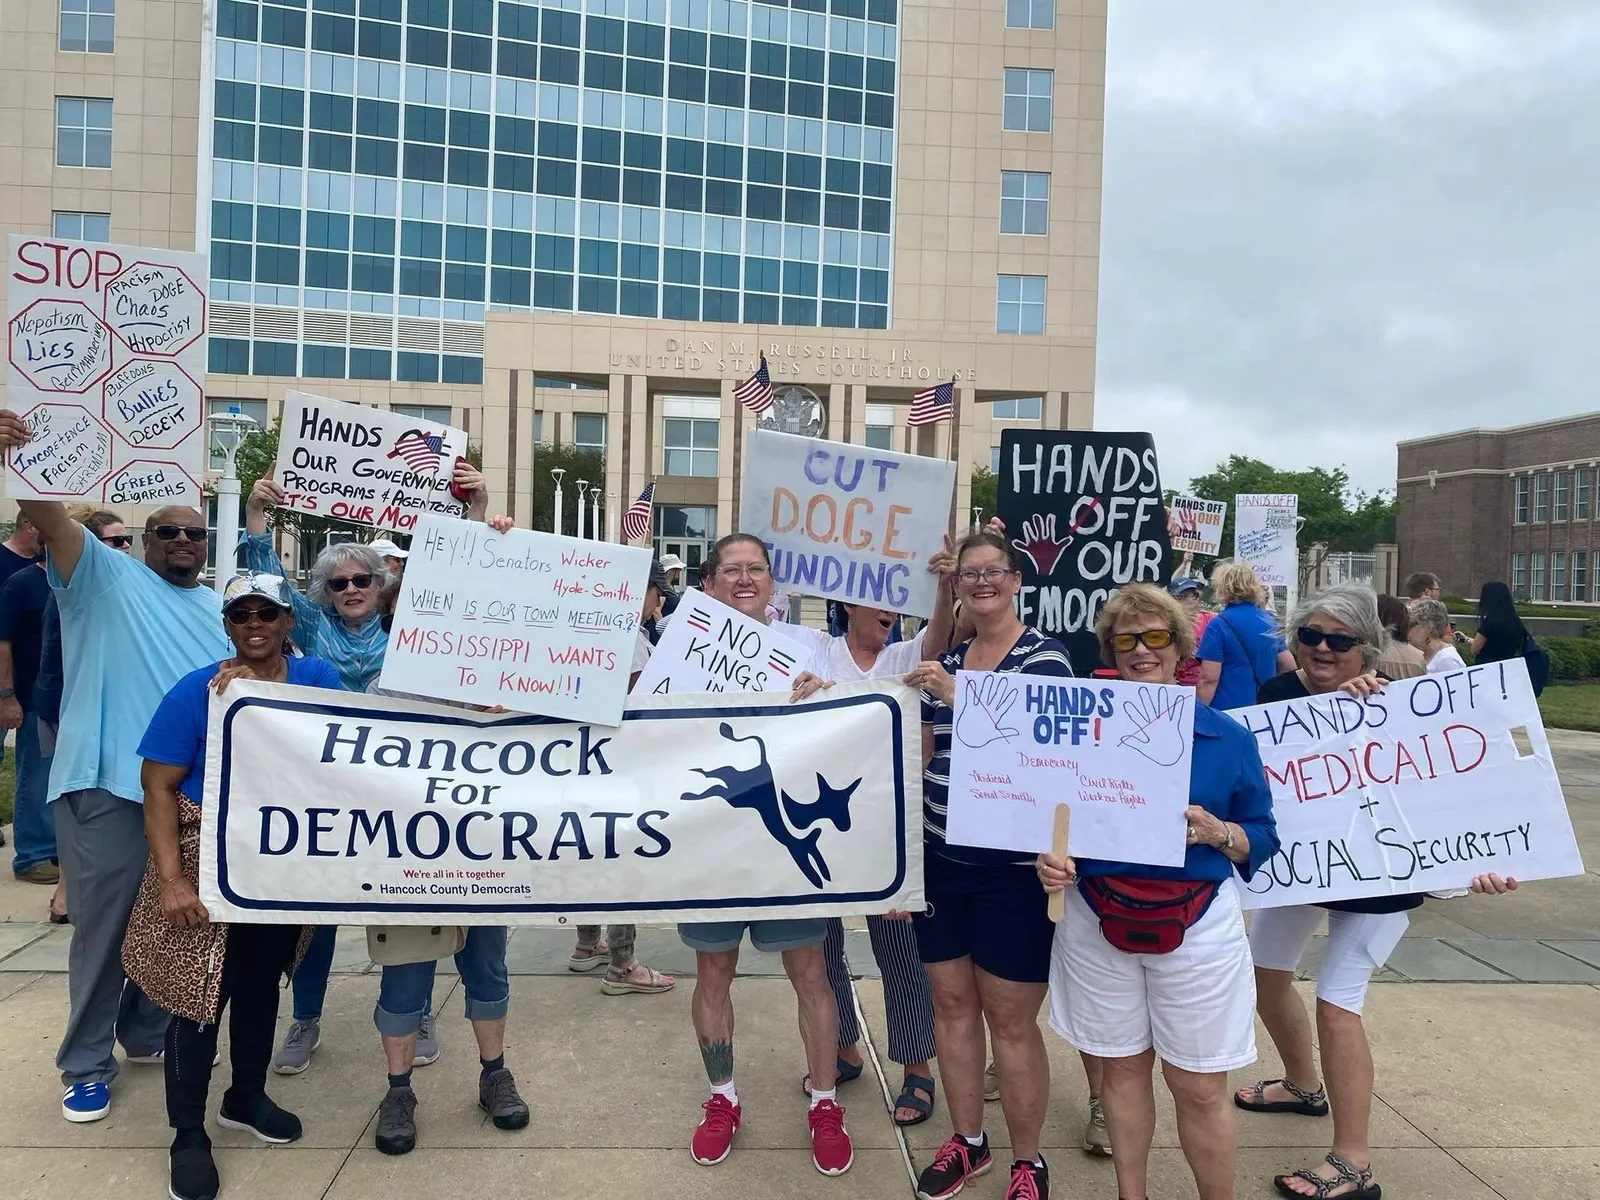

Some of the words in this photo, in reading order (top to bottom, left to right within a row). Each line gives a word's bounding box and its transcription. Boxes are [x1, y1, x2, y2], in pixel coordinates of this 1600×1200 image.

[12, 241, 122, 293] STOP
[116, 294, 169, 318] Chaos
[148, 277, 184, 302] DOGE
[16, 309, 88, 337] Nepotism
[608, 352, 703, 370] UNITED
[717, 356, 801, 375] STAES
[815, 362, 977, 382] COURTHOUSE
[666, 339, 715, 354] DAN
[729, 342, 754, 356] M.
[770, 343, 880, 363] RUSSELL,
[889, 348, 922, 364] JR.
[300, 407, 383, 448] HANDS
[292, 447, 337, 474] OUR
[804, 450, 900, 492] CUT
[1012, 443, 1159, 494] HANDS
[282, 470, 375, 501] PROGRAMS
[1237, 495, 1270, 507] HANDS
[331, 502, 374, 522] OUR
[377, 505, 418, 531] MON
[1069, 495, 1159, 541] OFF
[1175, 498, 1205, 511] HANDS
[1207, 502, 1223, 514] OFF
[424, 528, 476, 566] HEY!!
[479, 538, 552, 573] Senators
[561, 549, 611, 569] Wicker
[1172, 537, 1216, 554] ECURITY
[1177, 528, 1201, 540] OCIAL
[1077, 539, 1163, 584] OUR
[410, 587, 454, 611] WHEN
[464, 599, 477, 614] IS
[487, 600, 515, 620] OUR
[523, 605, 559, 621] TOWN
[1012, 585, 1119, 634] EMOC
[396, 627, 530, 663] MISSISSIPPI
[548, 645, 617, 671] WANTS
[718, 618, 761, 659] NO
[685, 638, 767, 692] KINGS
[1026, 684, 1115, 719] HANDS
[1243, 690, 1388, 746] HANDS
[1033, 715, 1101, 747] OFF!
[320, 722, 613, 777] Hancock
[1263, 724, 1487, 803] MEDICAID
[970, 788, 998, 800] Social
[1080, 774, 1107, 789] Civil
[1108, 778, 1135, 795] Rights
[258, 805, 672, 861] DEMOCRATS
[1375, 822, 1531, 881] SECURITY
[380, 883, 427, 895] Hancock
[430, 884, 468, 897] County
[471, 884, 531, 895] Democrats
[403, 869, 431, 879] We're
[433, 869, 444, 879] all
[445, 870, 455, 879] in
[456, 870, 464, 879] it
[465, 869, 506, 881] together
